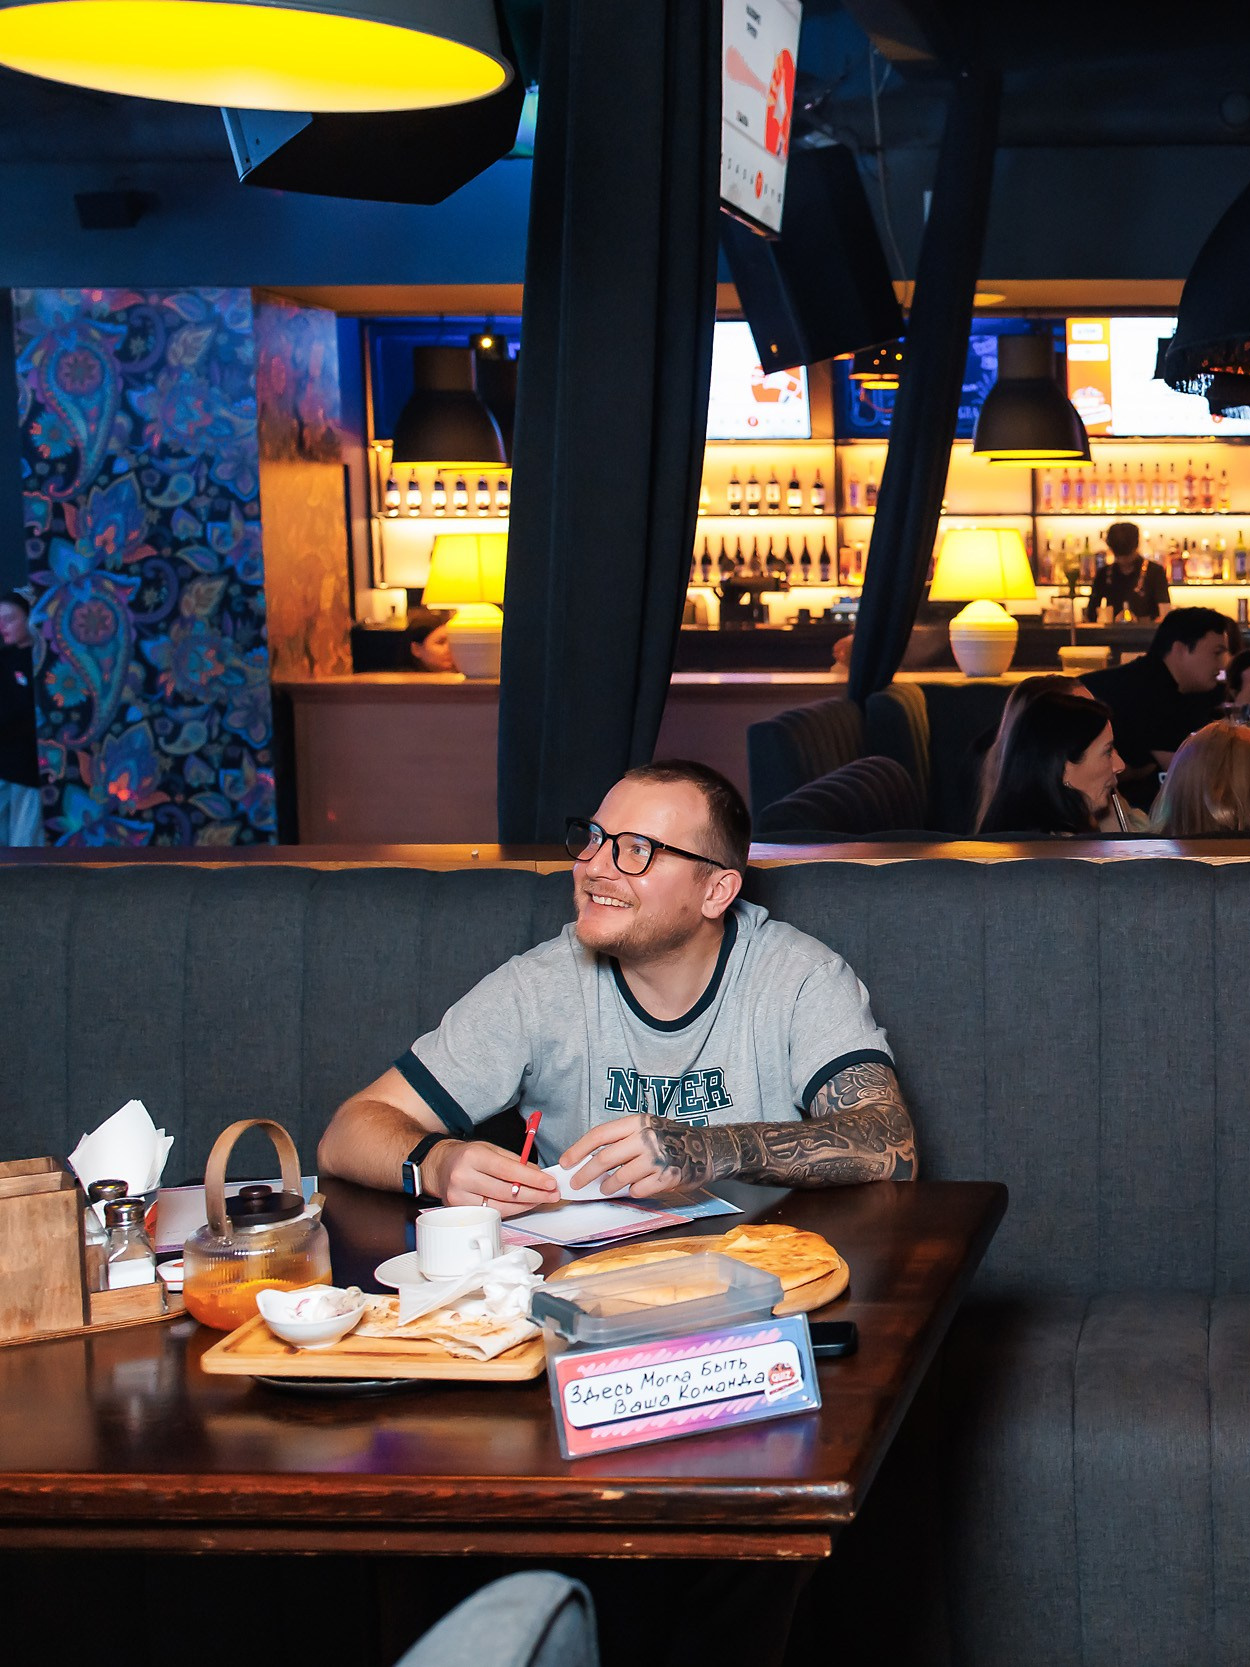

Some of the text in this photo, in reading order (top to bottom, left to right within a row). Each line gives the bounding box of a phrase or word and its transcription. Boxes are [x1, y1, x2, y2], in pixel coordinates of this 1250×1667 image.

[570, 1358, 748, 1404] Здесь Могла Быть
[613, 1394, 670, 1415] Ваша
[679, 1372, 765, 1401] Команда
